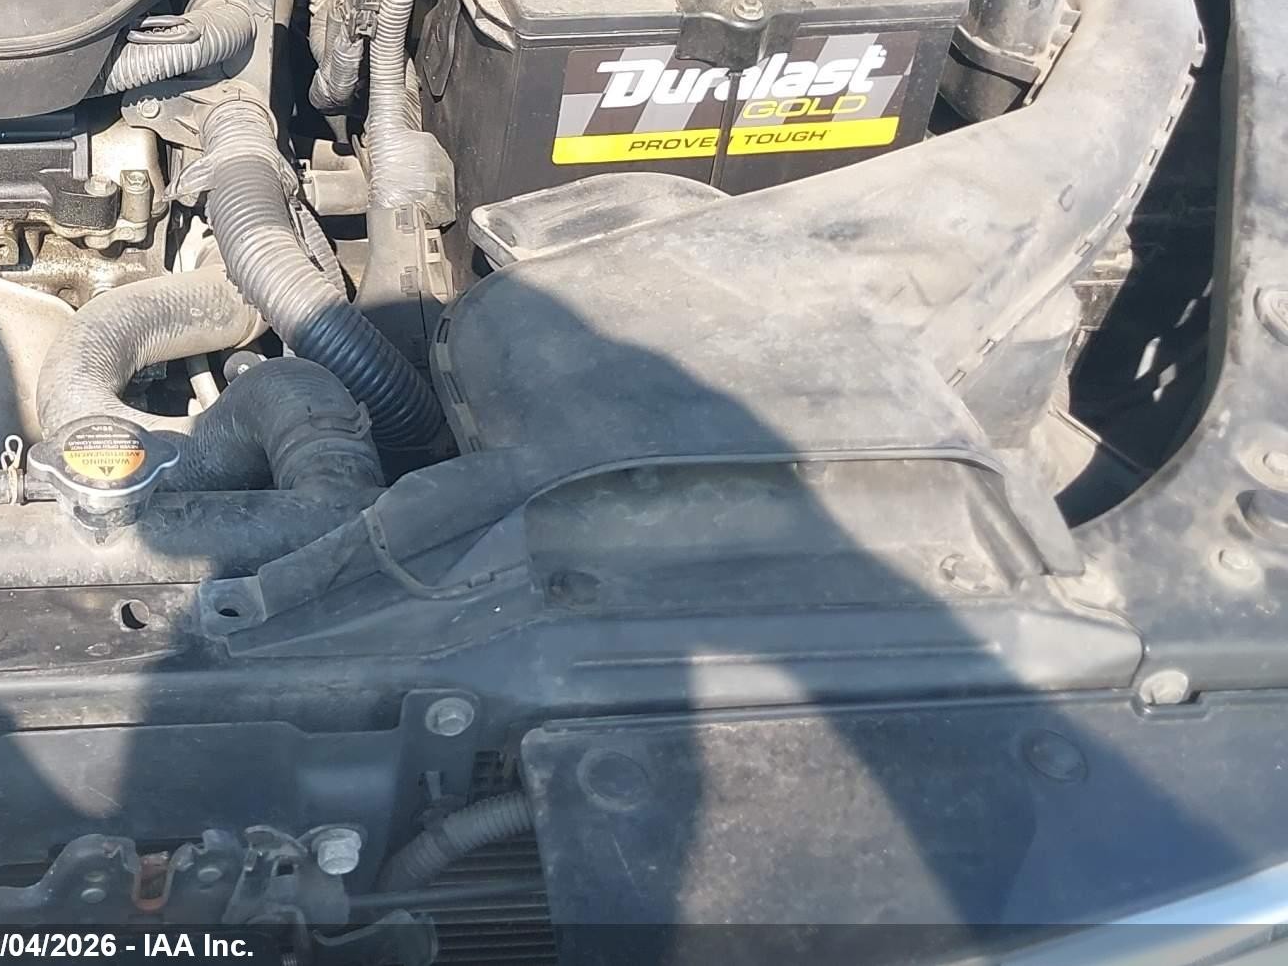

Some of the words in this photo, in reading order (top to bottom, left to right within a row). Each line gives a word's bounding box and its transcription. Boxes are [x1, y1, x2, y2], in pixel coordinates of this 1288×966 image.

[596, 44, 886, 109] Duralast
[743, 96, 867, 119] GOLD
[744, 130, 828, 145] TOUGH
